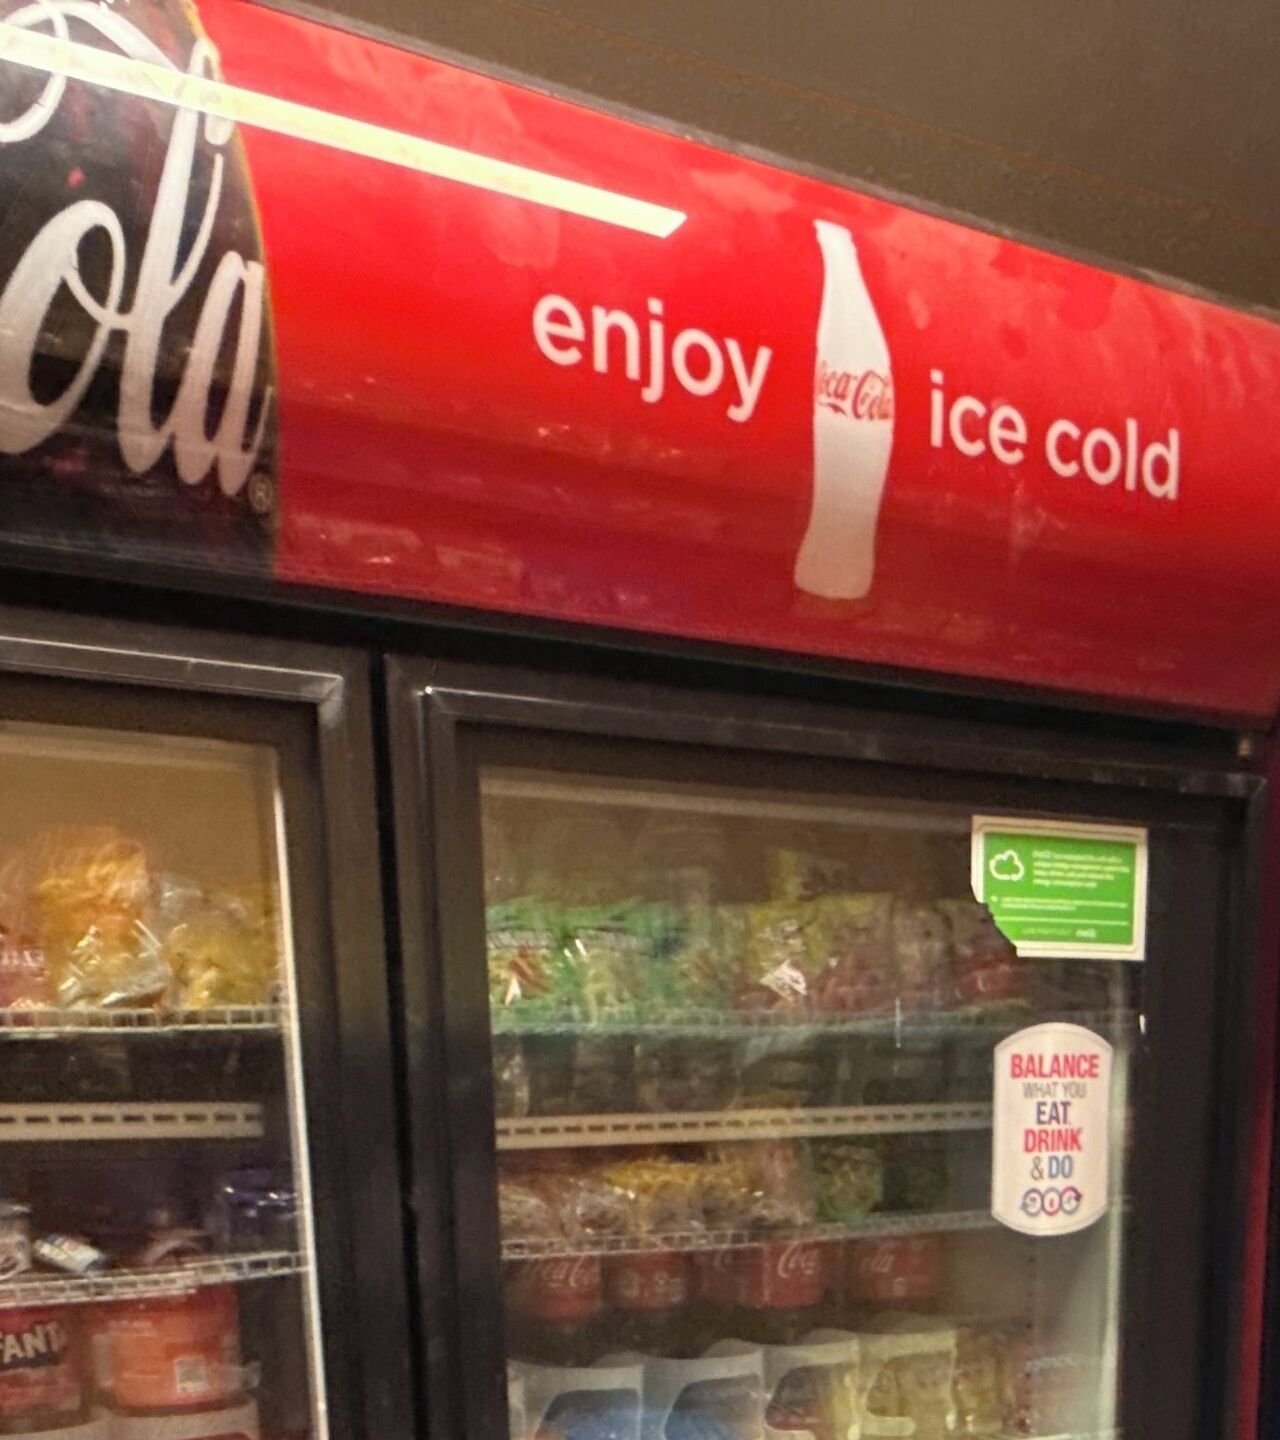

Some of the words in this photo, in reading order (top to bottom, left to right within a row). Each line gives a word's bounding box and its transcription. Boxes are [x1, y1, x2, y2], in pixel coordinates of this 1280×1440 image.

[532, 293, 771, 422] enjoy
[928, 370, 1028, 465] ice
[1044, 418, 1181, 500] cold
[1010, 1053, 1100, 1079] BALANCE
[1023, 1081, 1058, 1099] WHAT
[1061, 1081, 1087, 1099] YOU
[1023, 1127, 1083, 1153] DRINK
[1030, 1155, 1045, 1181] &
[1047, 1154, 1074, 1179] DO
